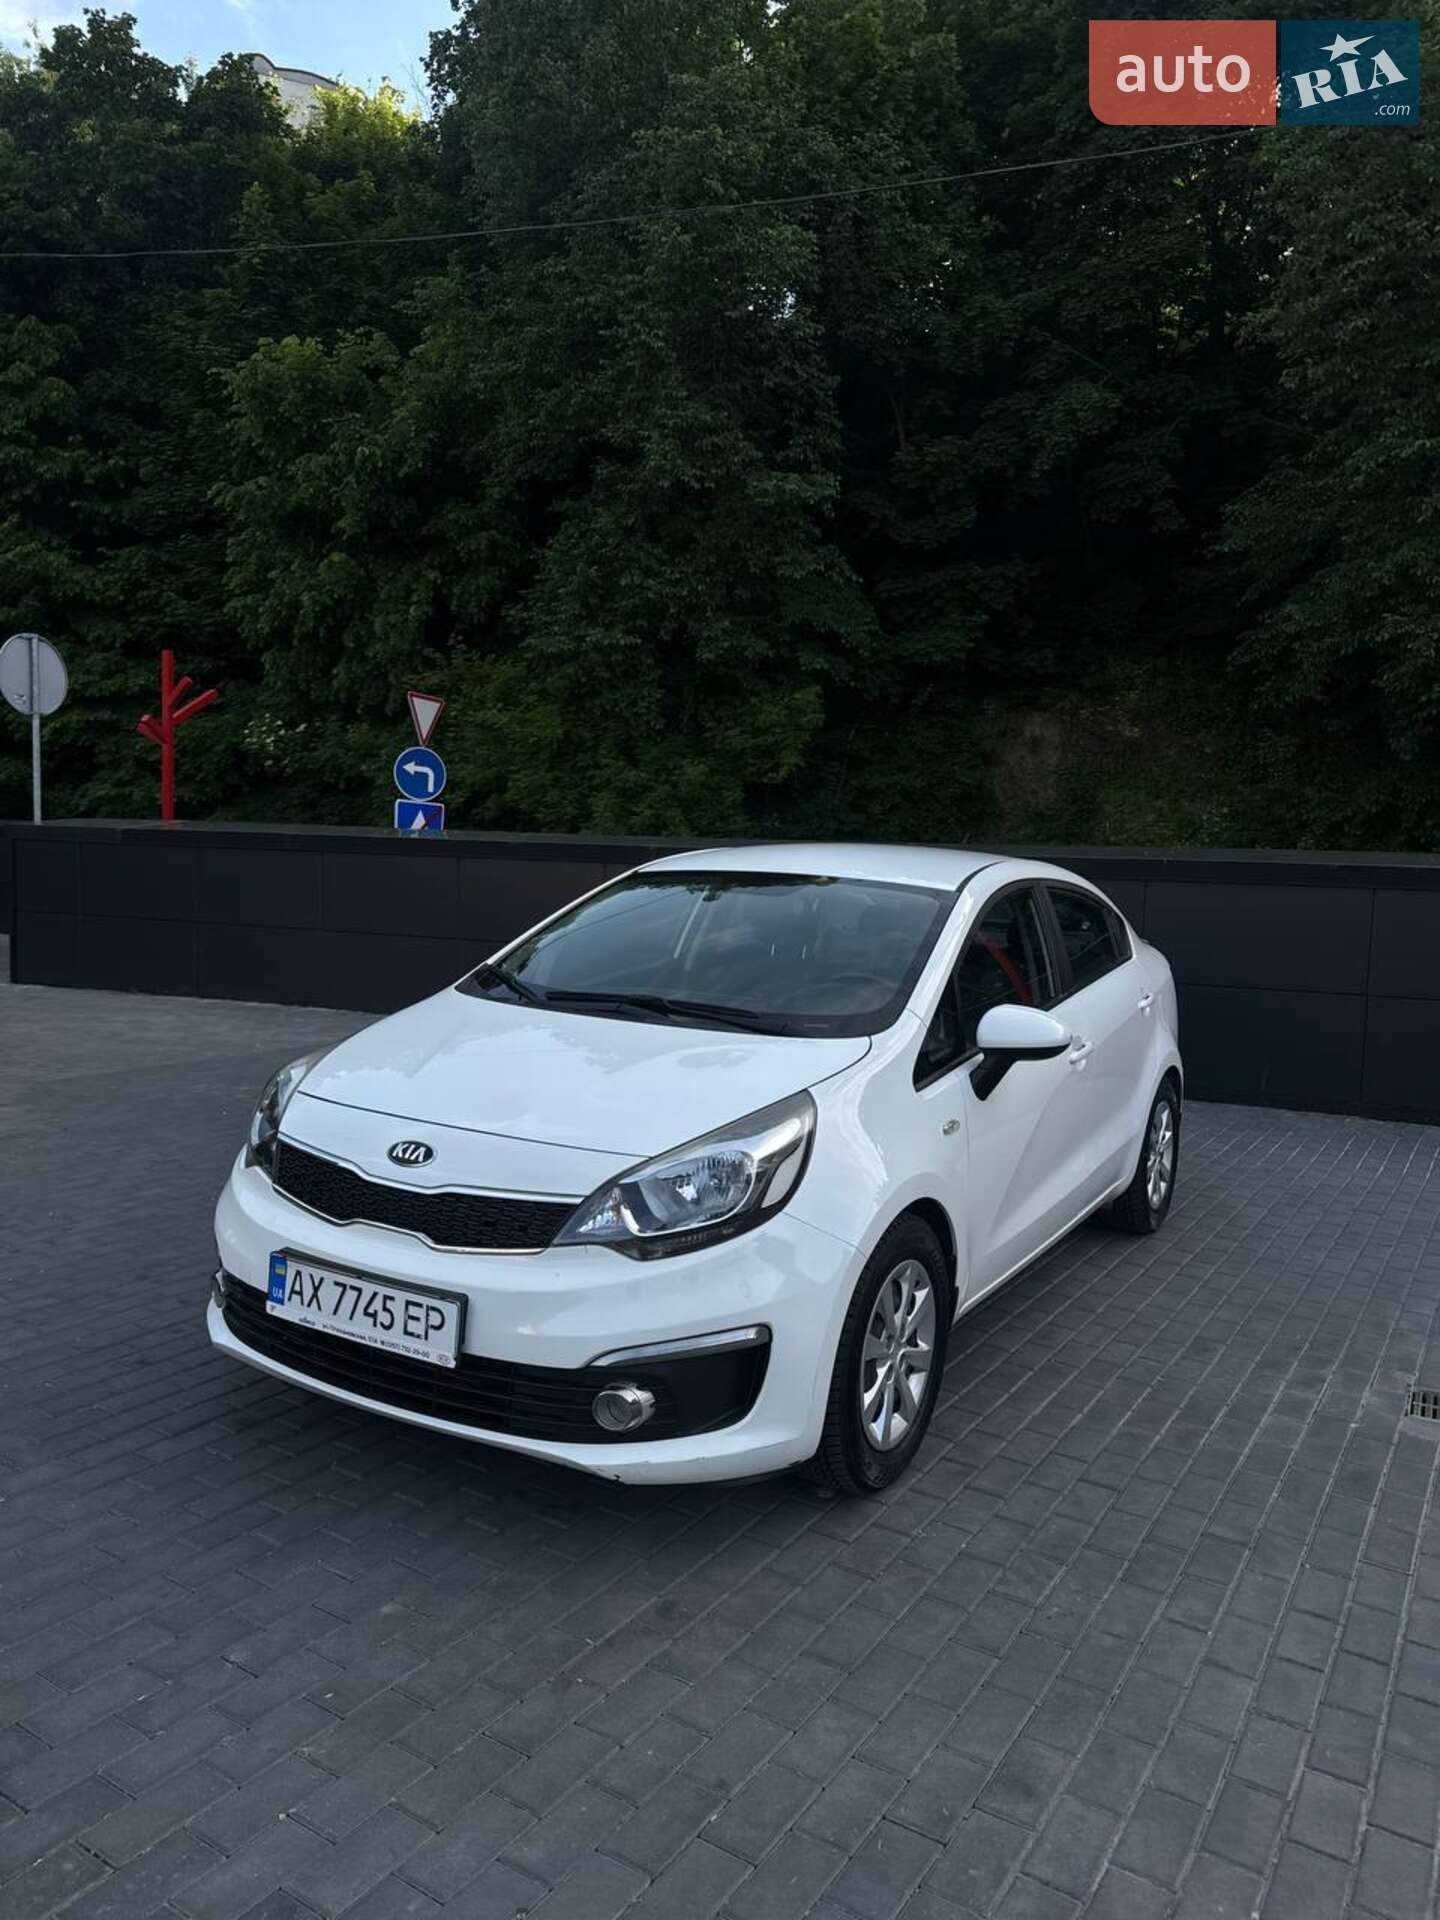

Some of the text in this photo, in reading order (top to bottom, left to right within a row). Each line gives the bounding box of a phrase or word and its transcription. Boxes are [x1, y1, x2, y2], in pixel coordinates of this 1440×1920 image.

[392, 1142, 427, 1162] KIA
[272, 1287, 283, 1298] UA
[288, 1270, 324, 1311] AX
[332, 1281, 396, 1331] 7745
[403, 1299, 446, 1341] EP
